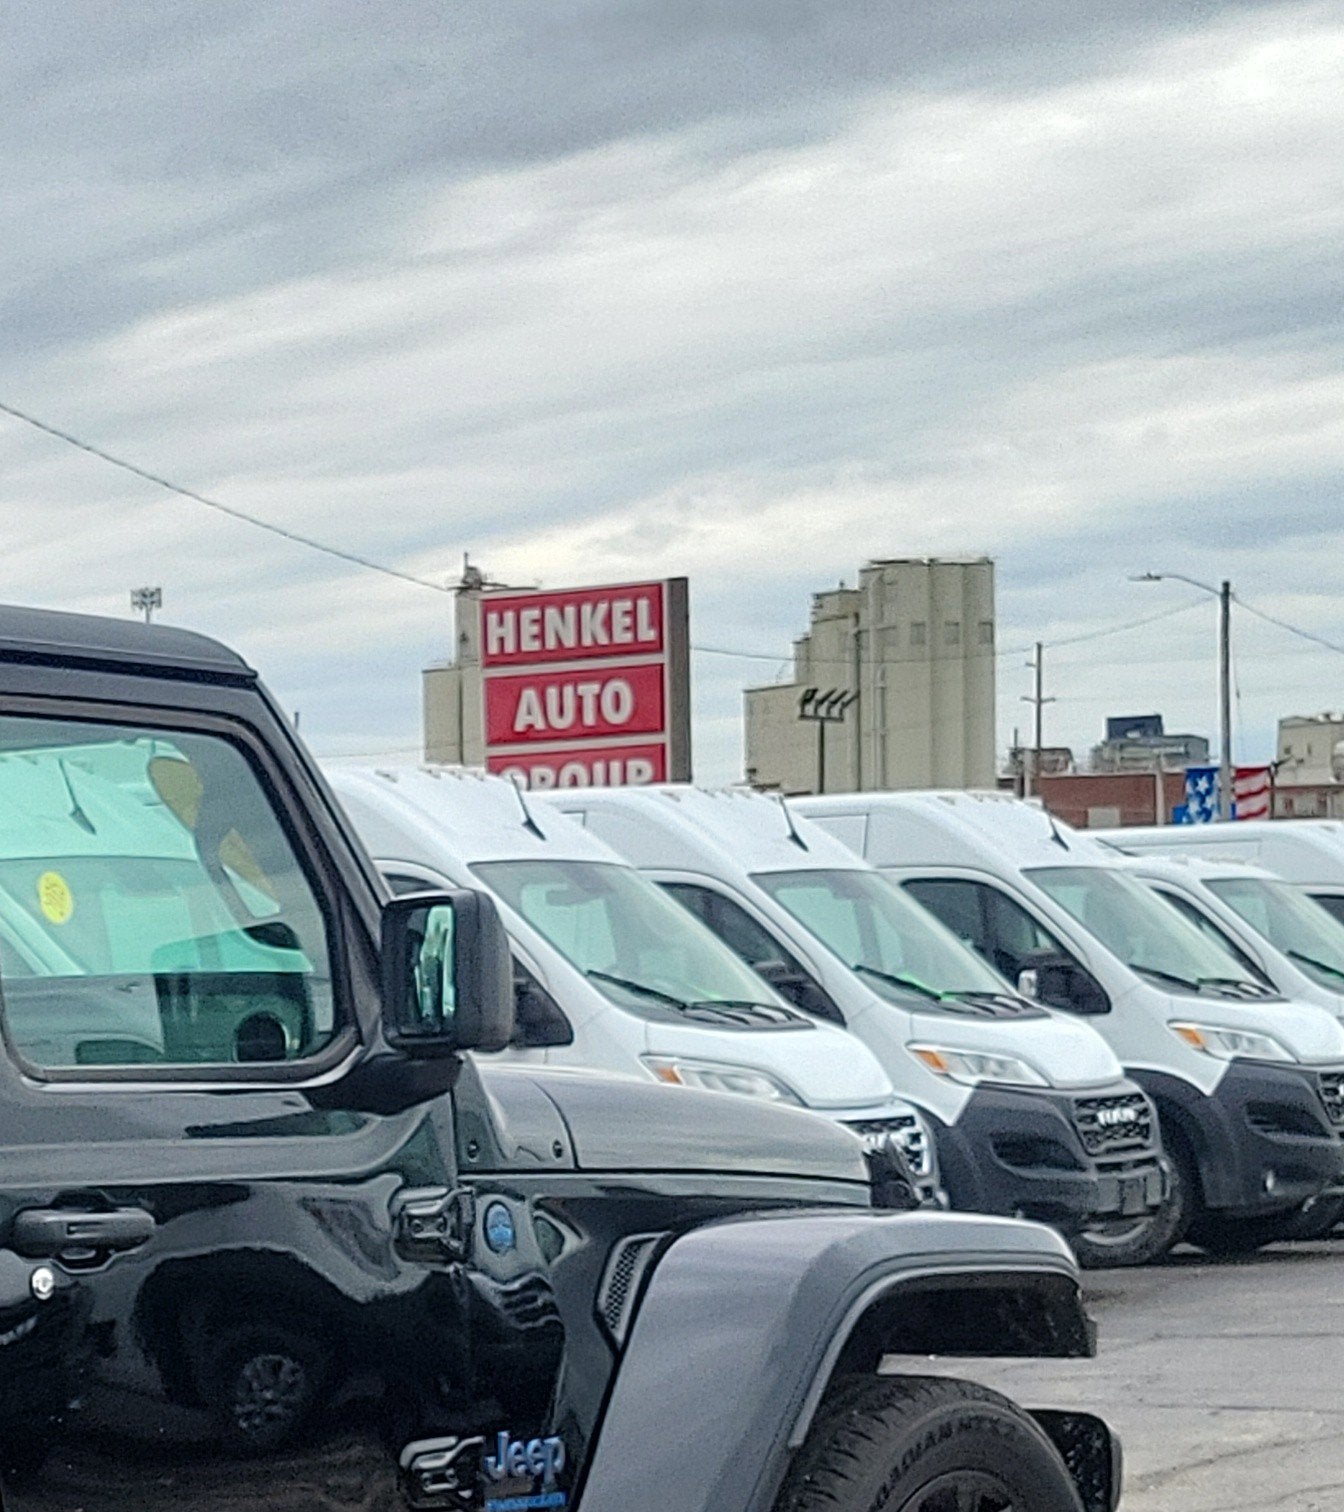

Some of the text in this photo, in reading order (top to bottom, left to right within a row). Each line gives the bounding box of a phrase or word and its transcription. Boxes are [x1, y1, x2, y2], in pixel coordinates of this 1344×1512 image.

[486, 596, 657, 656] HENKEL
[513, 677, 635, 733] AUTO
[483, 1429, 568, 1485] Jeep
